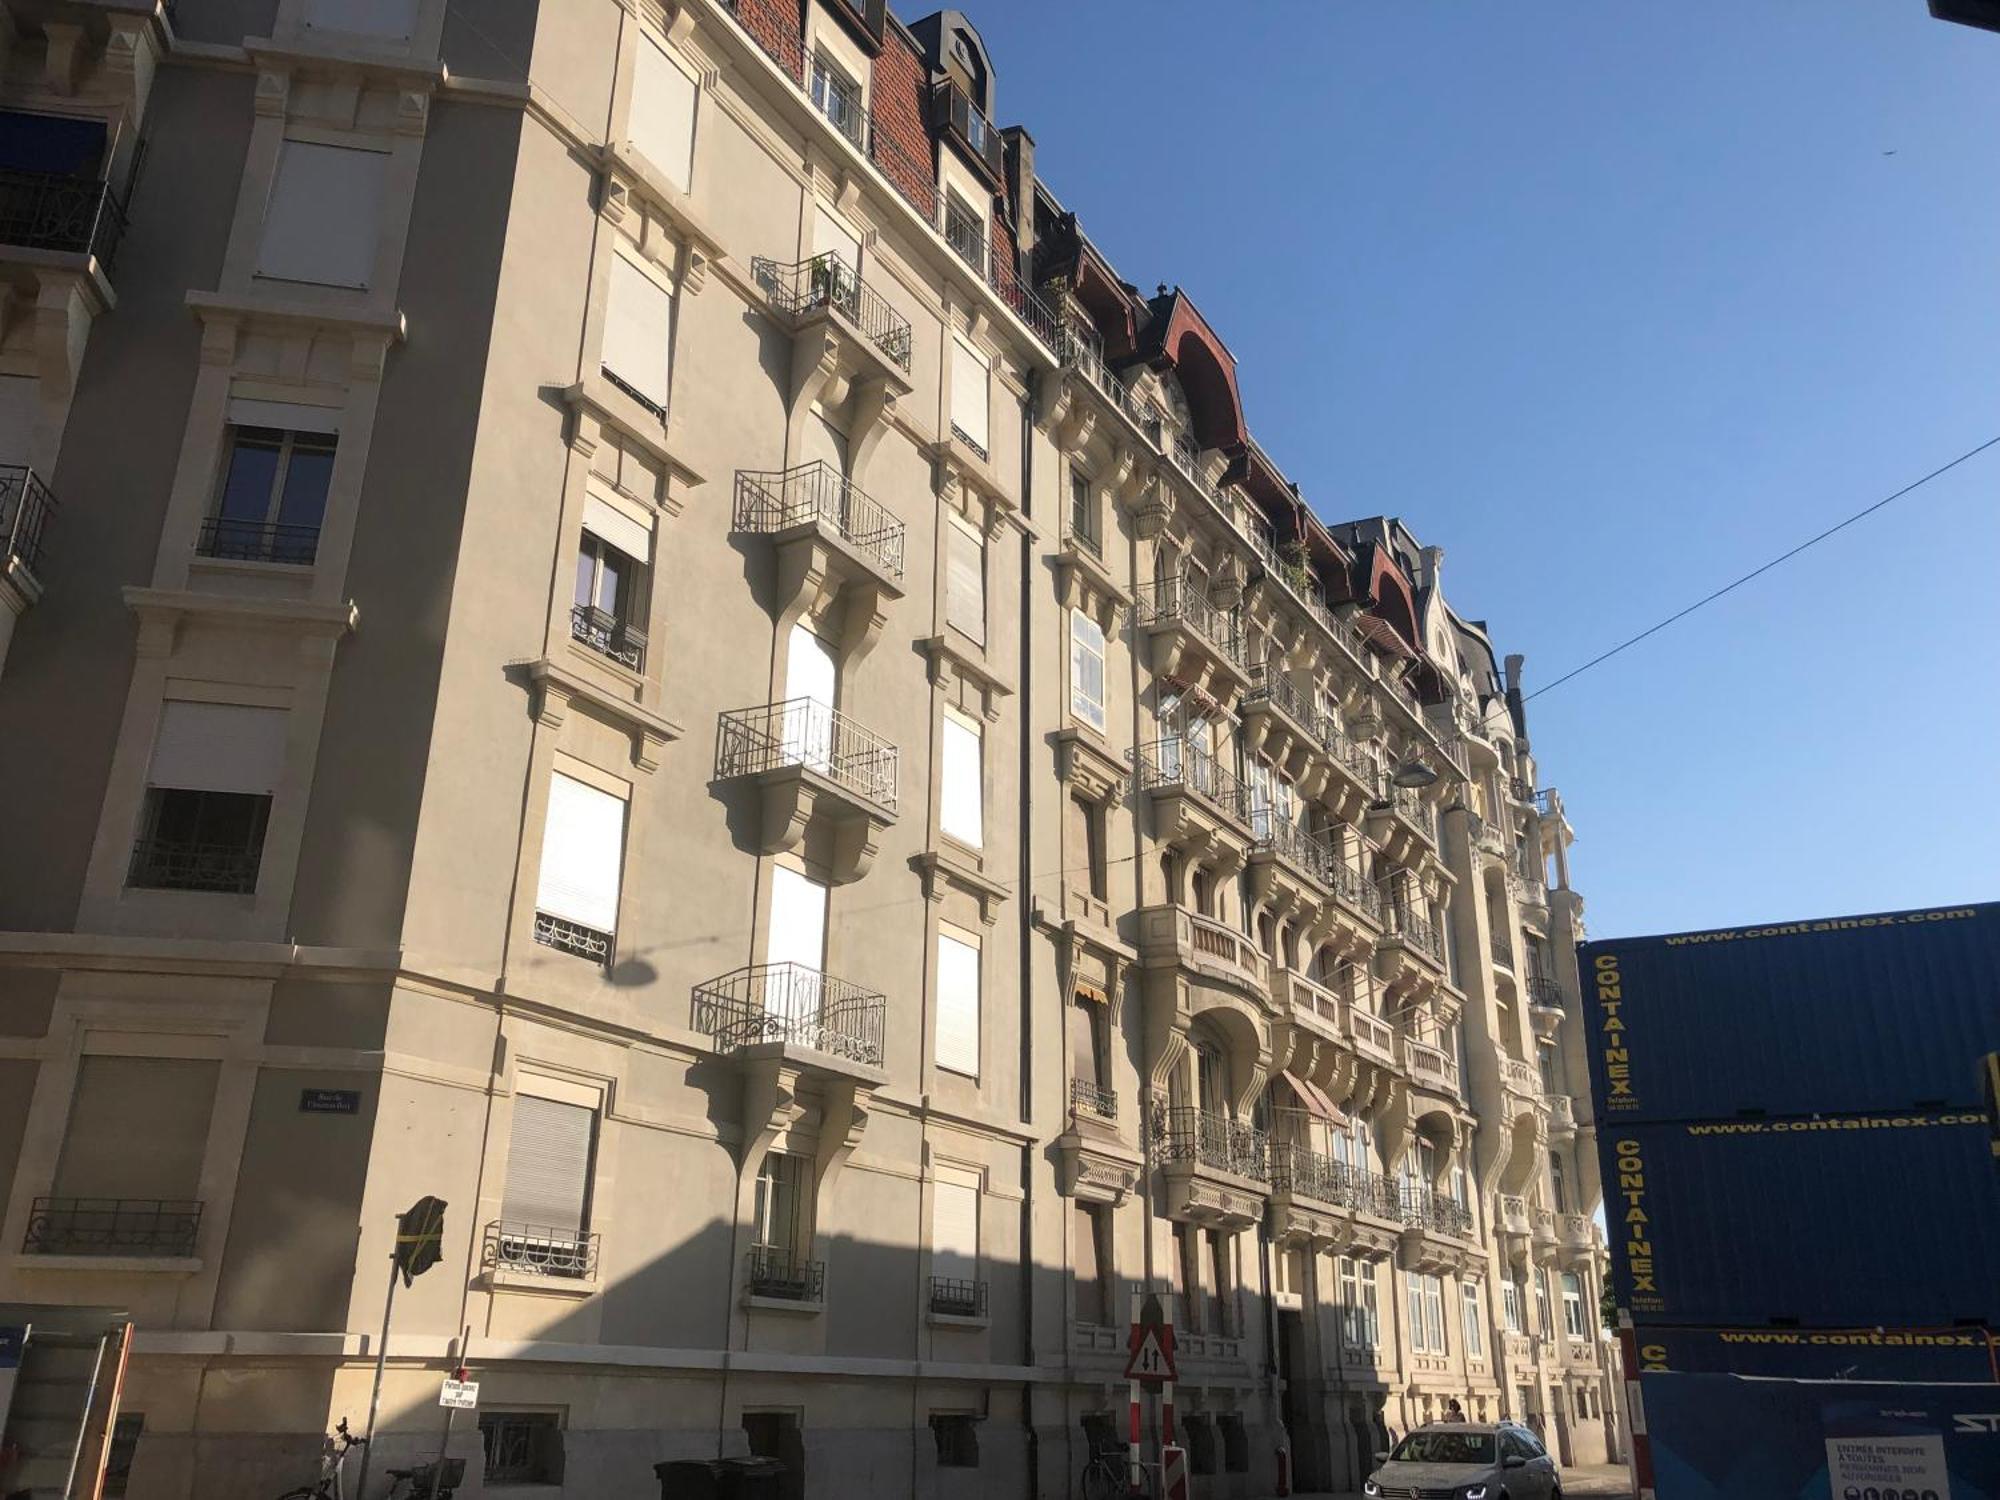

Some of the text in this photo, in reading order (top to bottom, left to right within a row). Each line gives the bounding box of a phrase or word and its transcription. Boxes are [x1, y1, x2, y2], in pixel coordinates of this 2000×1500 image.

[1665, 908, 1976, 946] www.containex.com
[1595, 955, 1632, 1095] CONTAINEX
[1616, 1140, 1656, 1292] CONTAINEX
